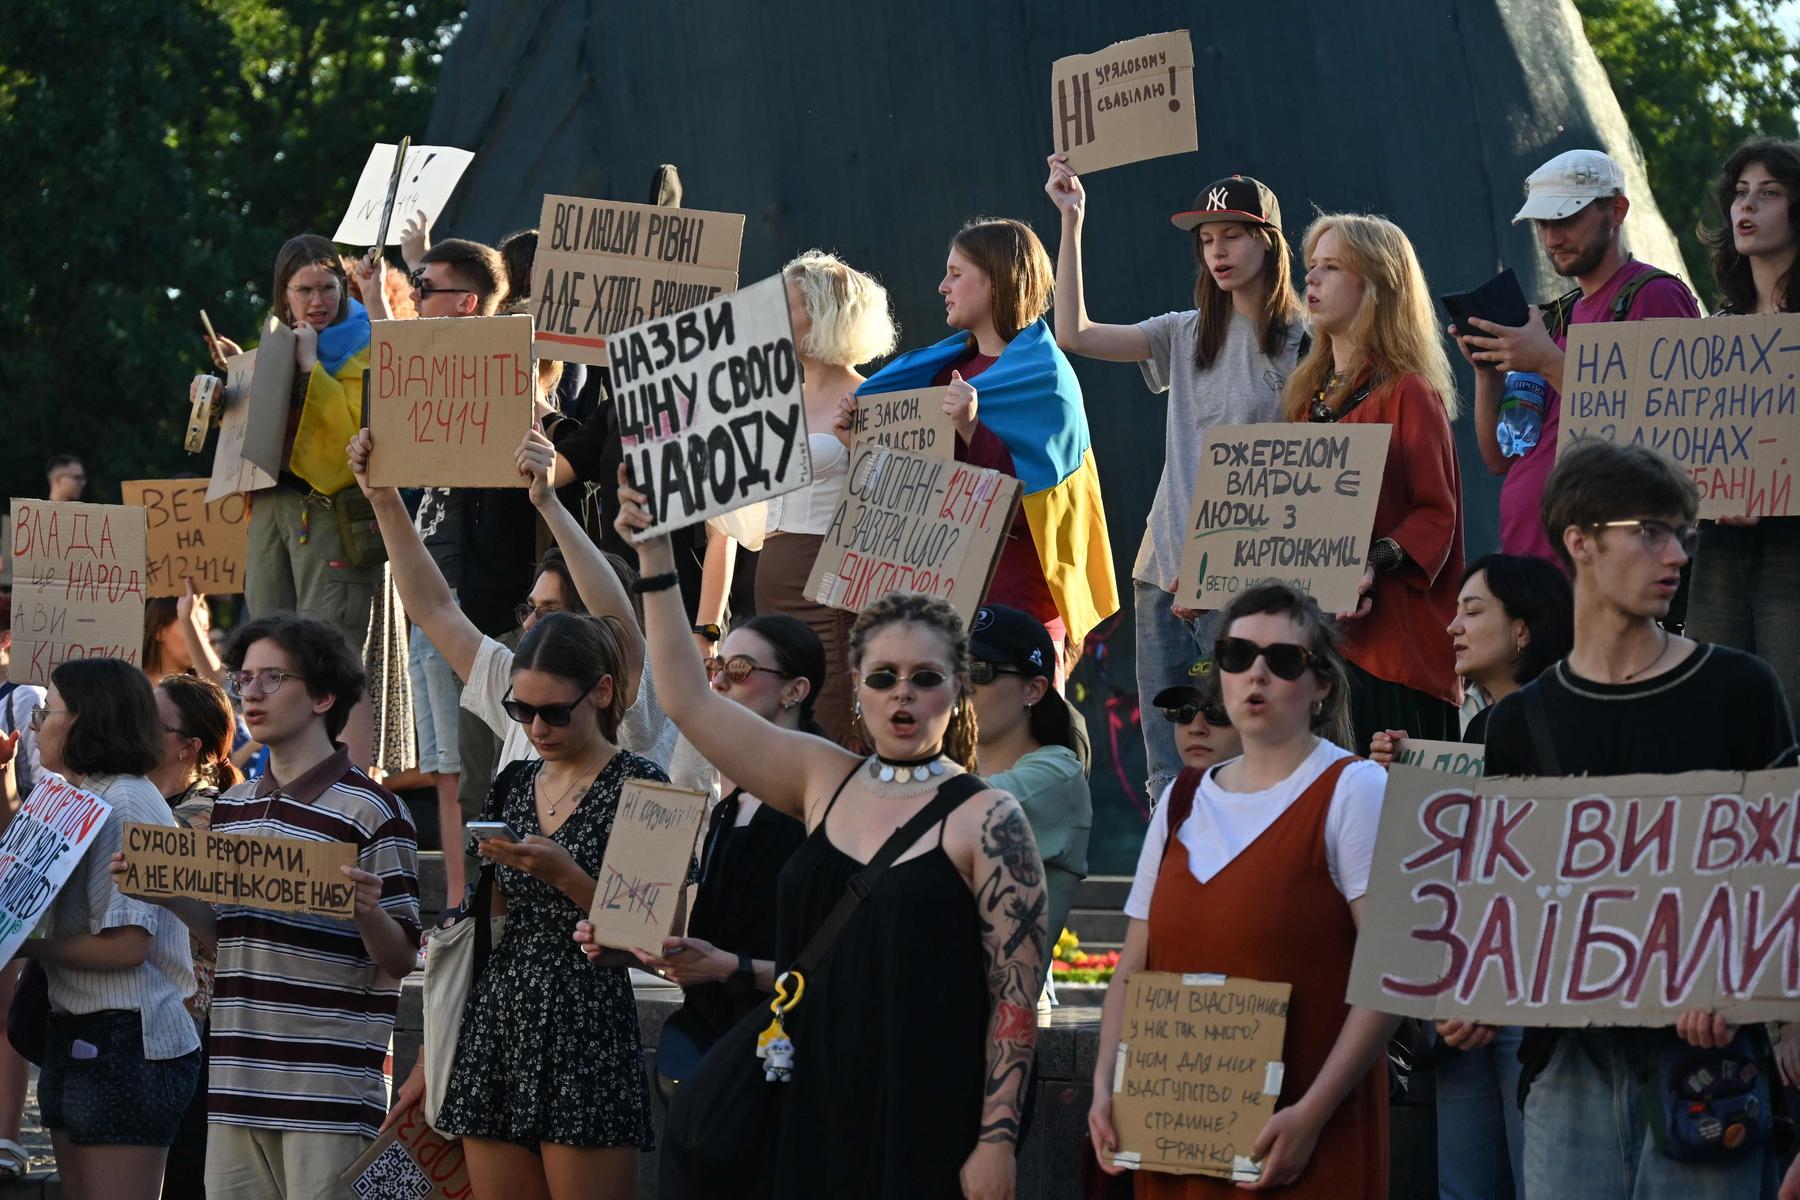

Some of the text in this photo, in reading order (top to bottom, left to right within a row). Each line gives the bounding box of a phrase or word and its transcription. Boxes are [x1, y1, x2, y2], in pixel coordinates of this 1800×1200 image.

[1095, 51, 1166, 85] УРЯДОВОМУ
[1058, 72, 1095, 152] НІ
[551, 203, 704, 264] ВСІ ЛЮДИ РІВНІ
[535, 268, 585, 334] АЛЕ
[609, 301, 735, 389] НАЗВИ
[1577, 341, 1627, 384] НА
[618, 338, 795, 444] ЦІНУ СВОГО
[1571, 373, 1796, 421] ІВАН БАГРЯНИЙ
[408, 400, 488, 444] 12414
[625, 403, 799, 532] НАРОДУ
[1210, 436, 1351, 469] ДЖЕРЕЛОМ
[1227, 467, 1322, 497] ВЛАДИ
[15, 506, 116, 560] ВЛАДА
[825, 500, 858, 545] А
[843, 504, 907, 560] ЗАВТРА
[1195, 500, 1270, 530] ЛЮДИ
[177, 530, 205, 549] НА
[1233, 535, 1361, 567] КАРТОНКАМИ
[66, 561, 144, 606] НАРОД
[32, 602, 67, 637] ВИ
[1399, 789, 1537, 886] ЯК
[1557, 795, 1679, 881] ВИ
[126, 862, 139, 889] А
[146, 865, 169, 889] НЕ
[311, 881, 355, 908] НАБУ
[1147, 987, 1180, 1013] ЧОМ
[1177, 1050, 1211, 1074] ДЛЯ
